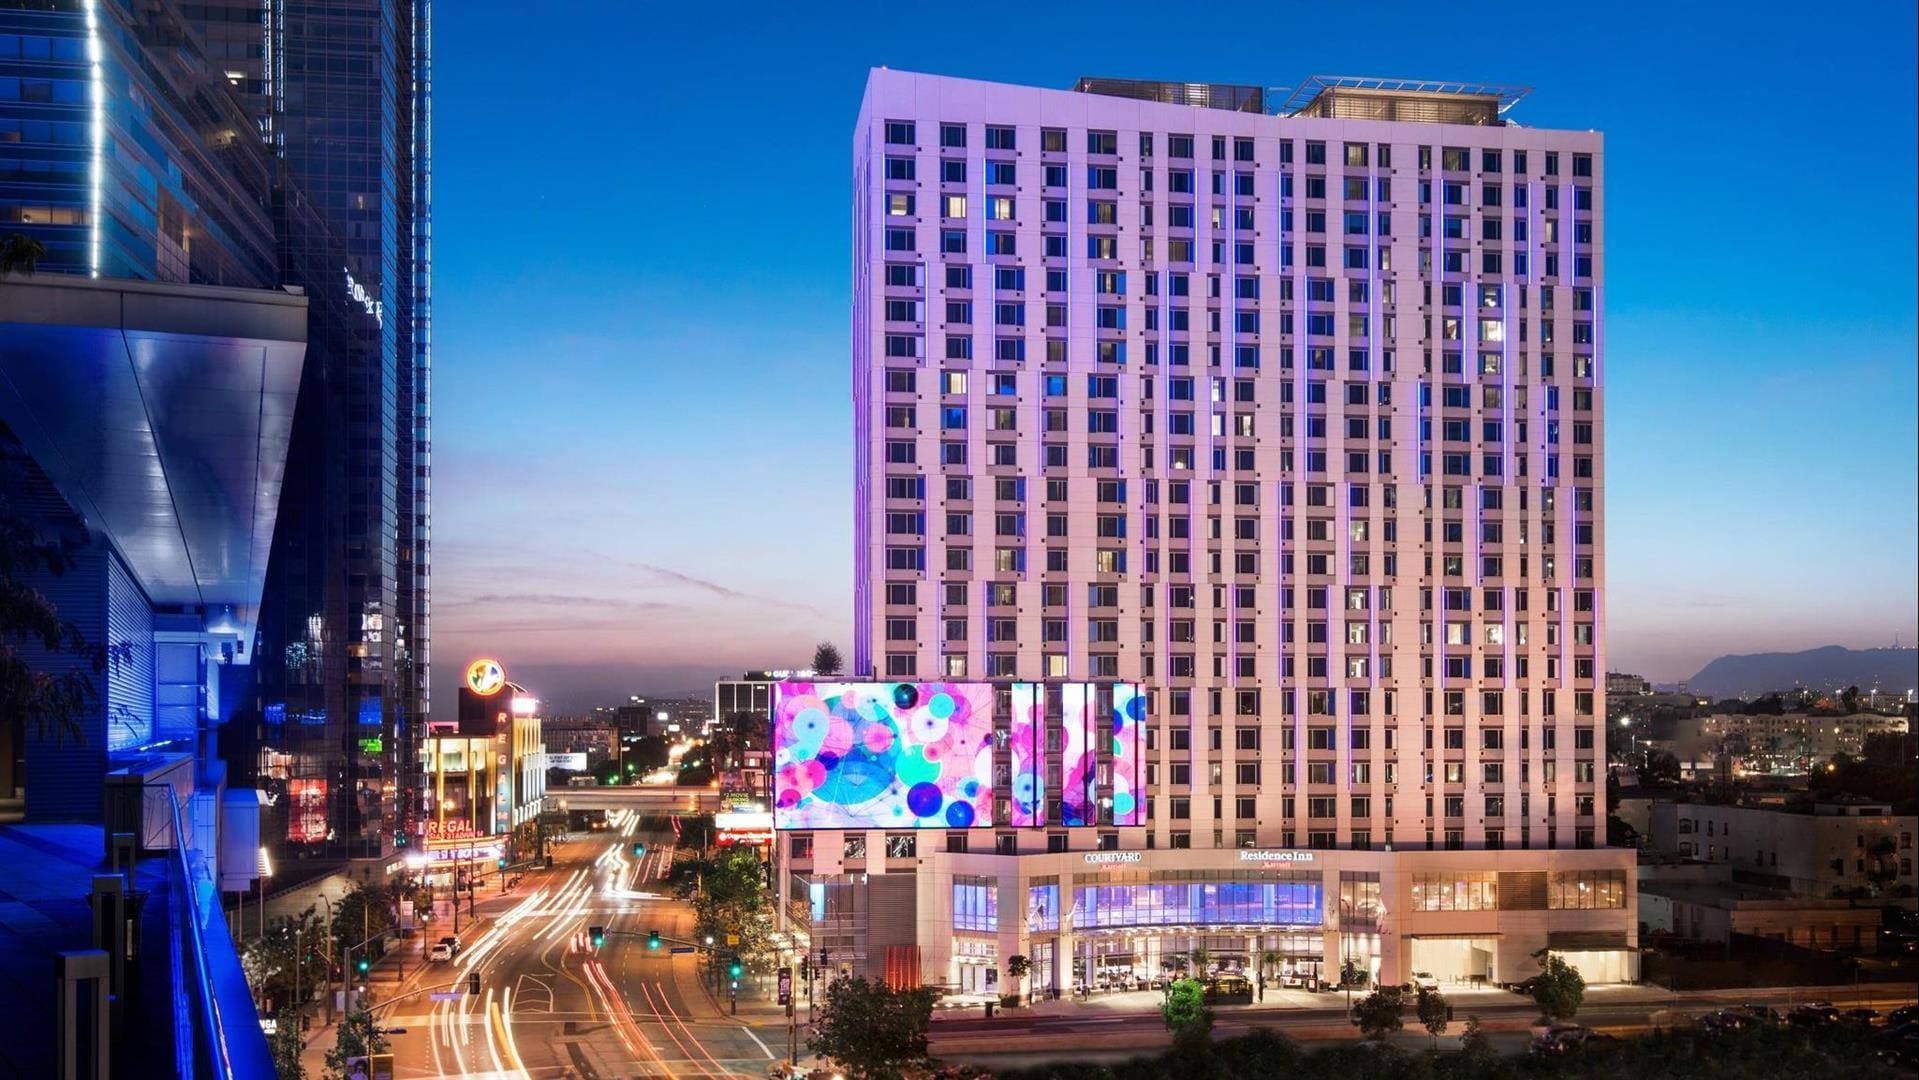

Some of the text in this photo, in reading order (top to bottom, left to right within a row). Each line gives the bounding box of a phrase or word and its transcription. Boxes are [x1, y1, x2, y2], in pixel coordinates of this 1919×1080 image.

[497, 712, 508, 805] REGAL
[428, 820, 473, 834] REGAL
[1085, 852, 1142, 864] COURTYARD
[1240, 851, 1313, 862] Residence Inn
